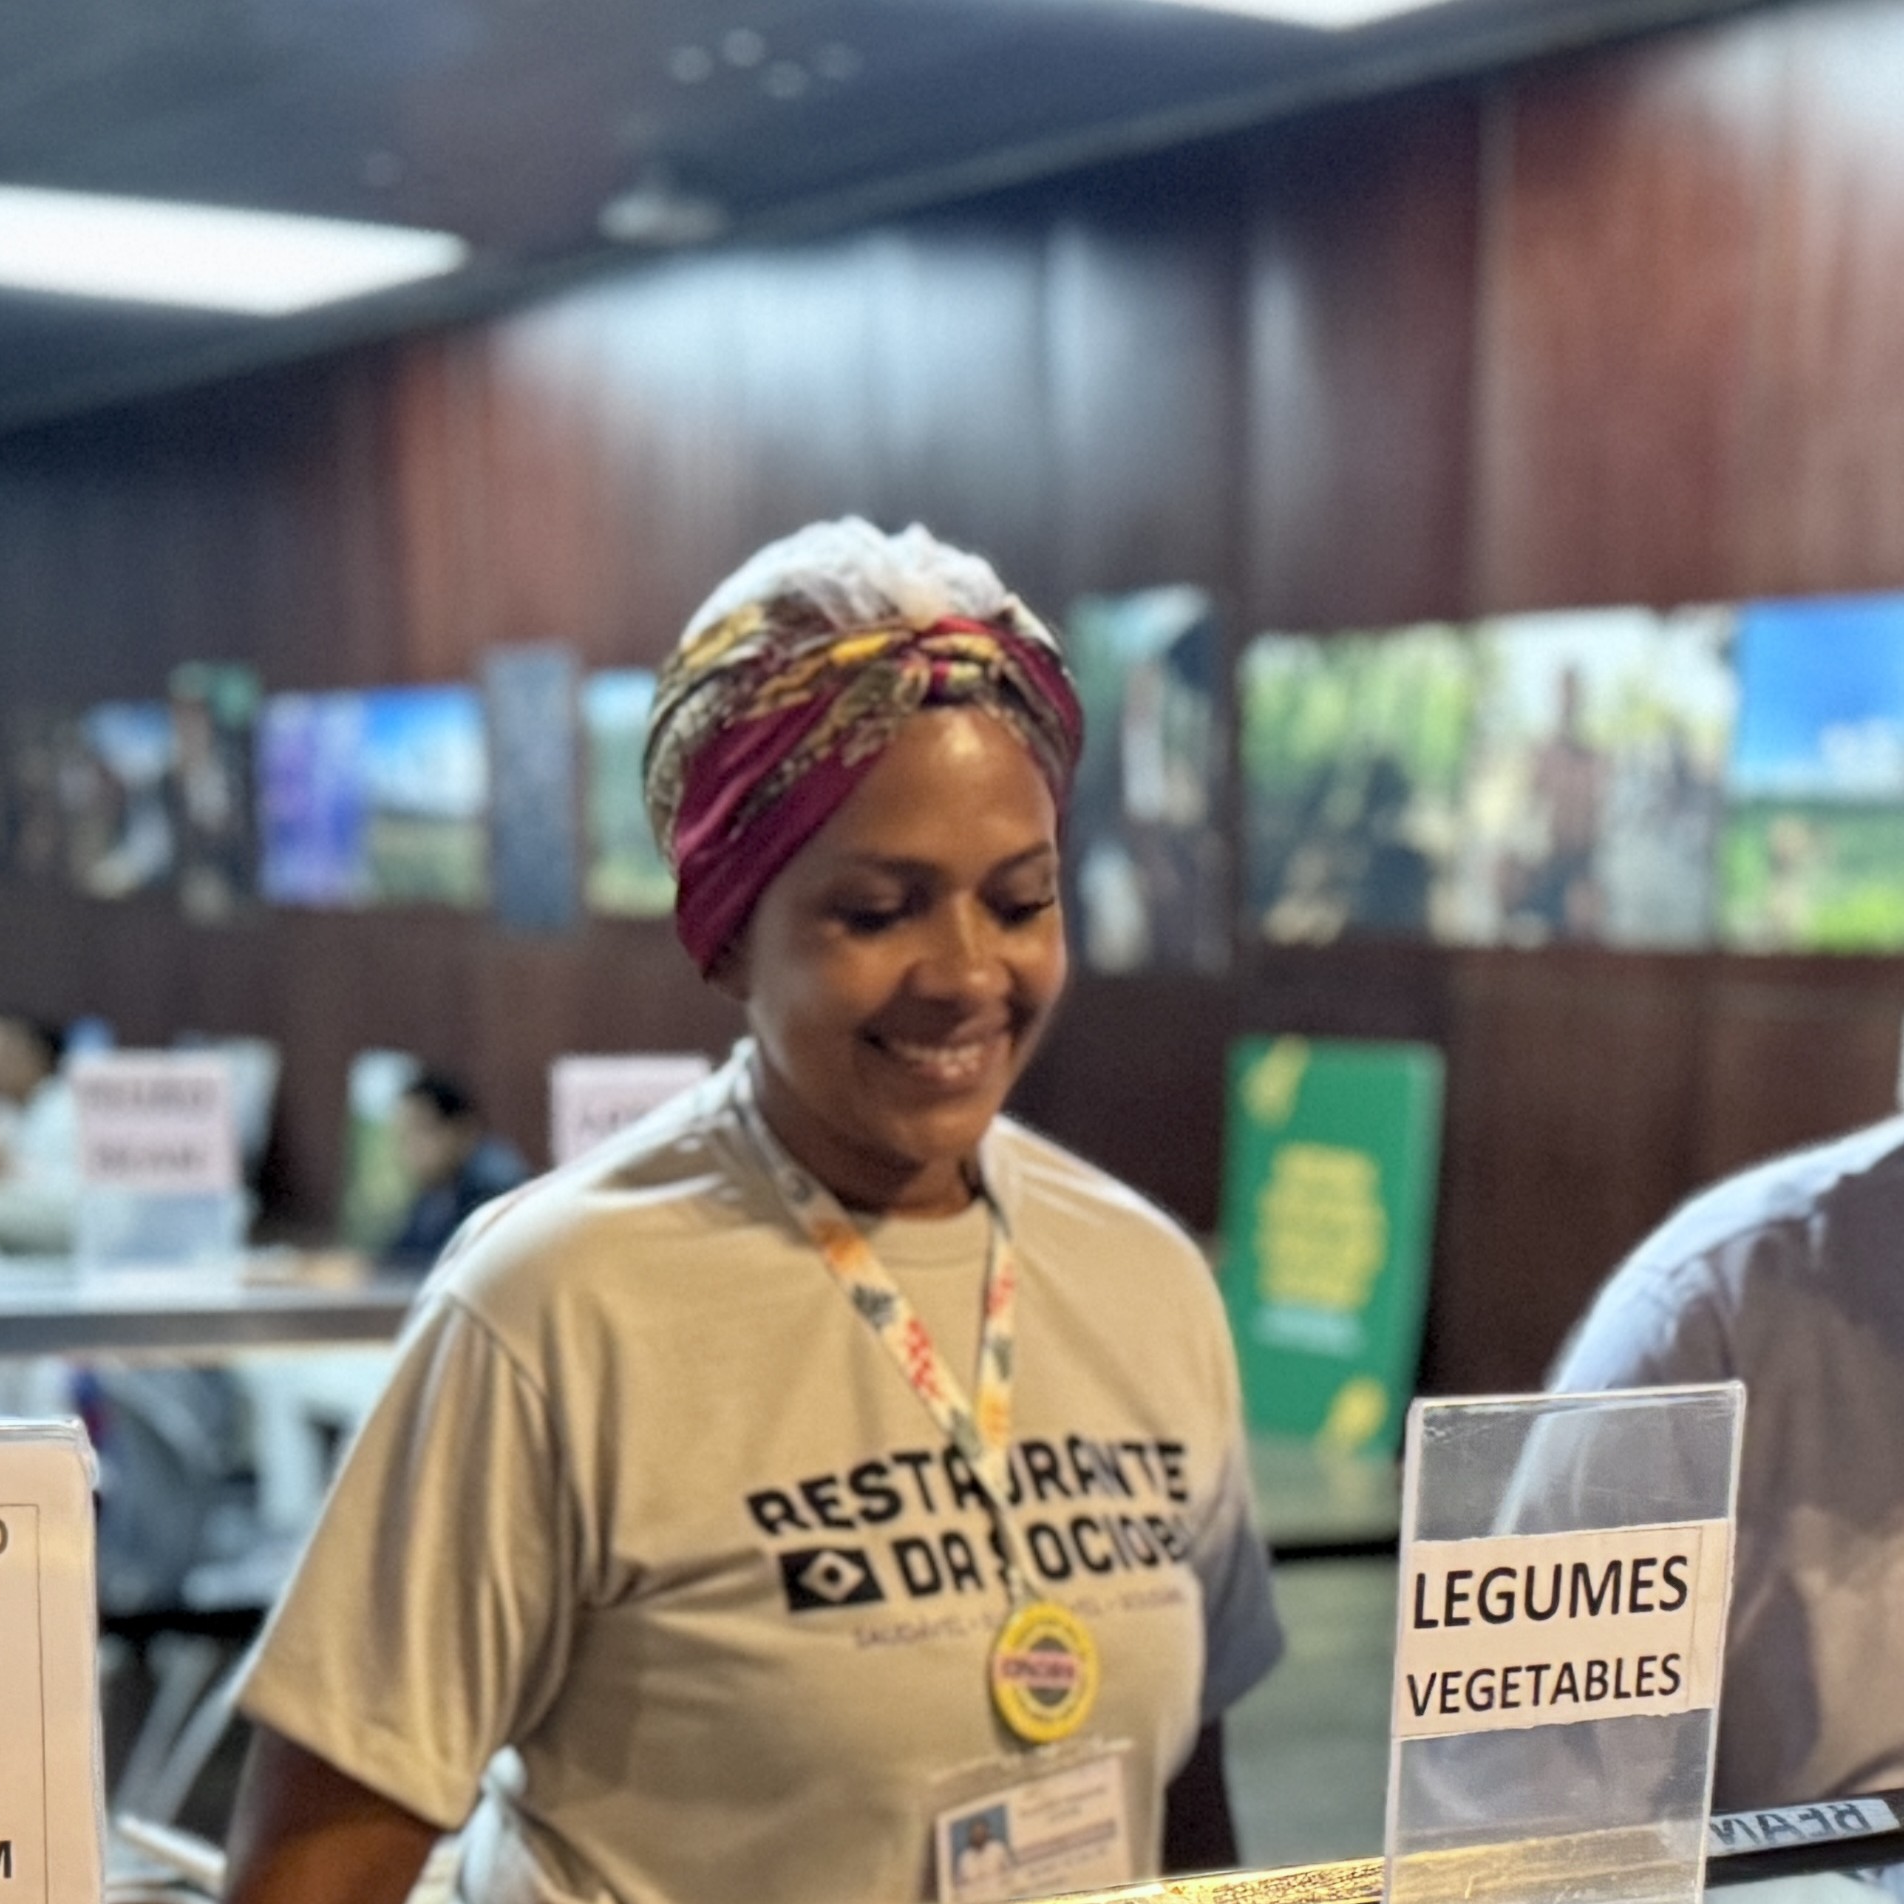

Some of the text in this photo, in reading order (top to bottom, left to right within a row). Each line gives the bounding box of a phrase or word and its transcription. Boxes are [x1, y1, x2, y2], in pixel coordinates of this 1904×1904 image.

[892, 1530, 983, 1597] DA
[1414, 1555, 1687, 1629] LEGUMES
[1407, 1653, 1680, 1716] VEGETABLES
